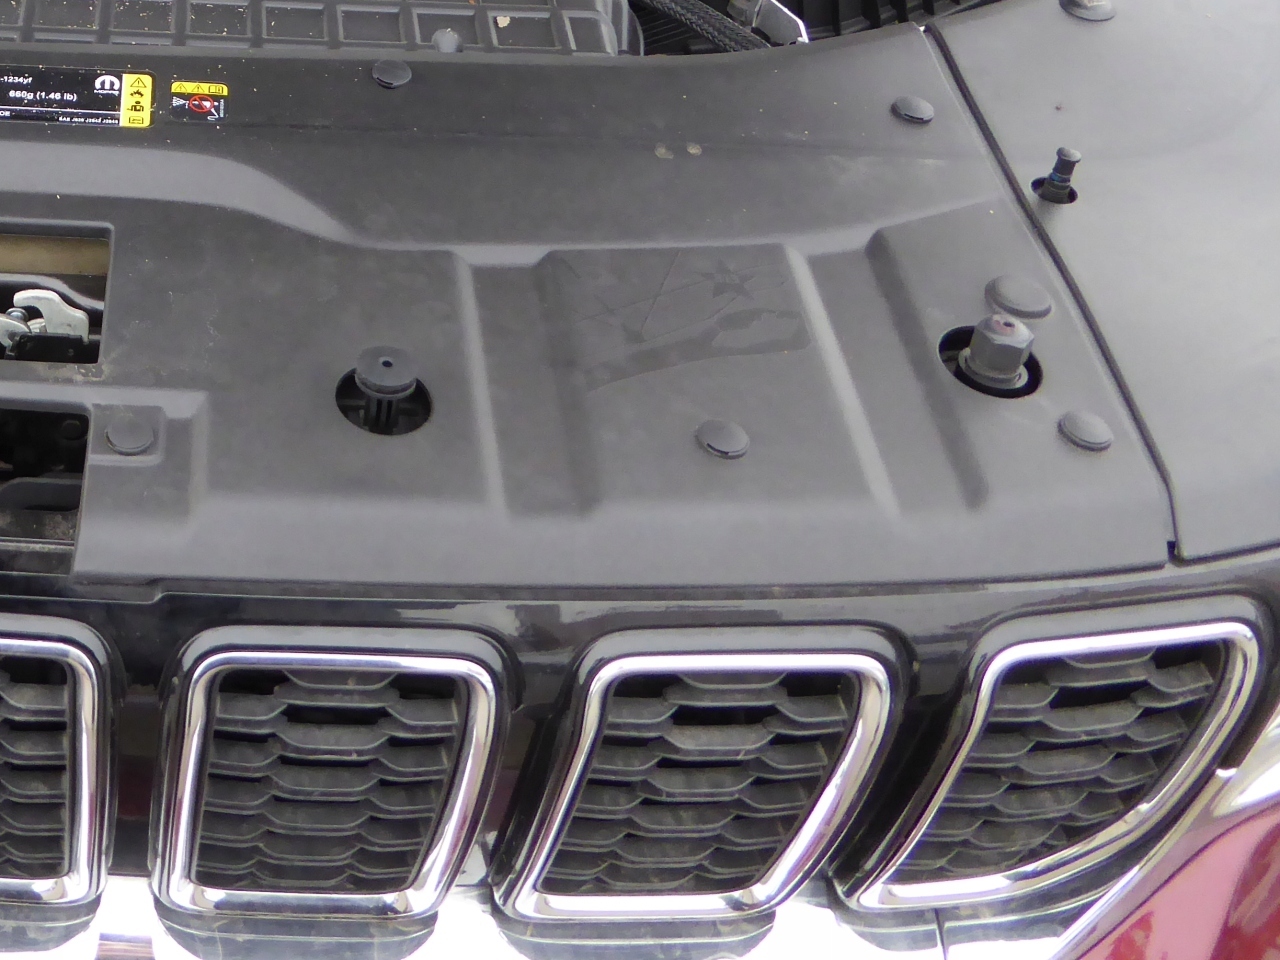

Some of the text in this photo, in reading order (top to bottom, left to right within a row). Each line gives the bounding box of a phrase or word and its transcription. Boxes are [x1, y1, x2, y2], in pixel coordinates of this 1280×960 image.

[9, 90, 77, 101] 660g (1.46 lb)
